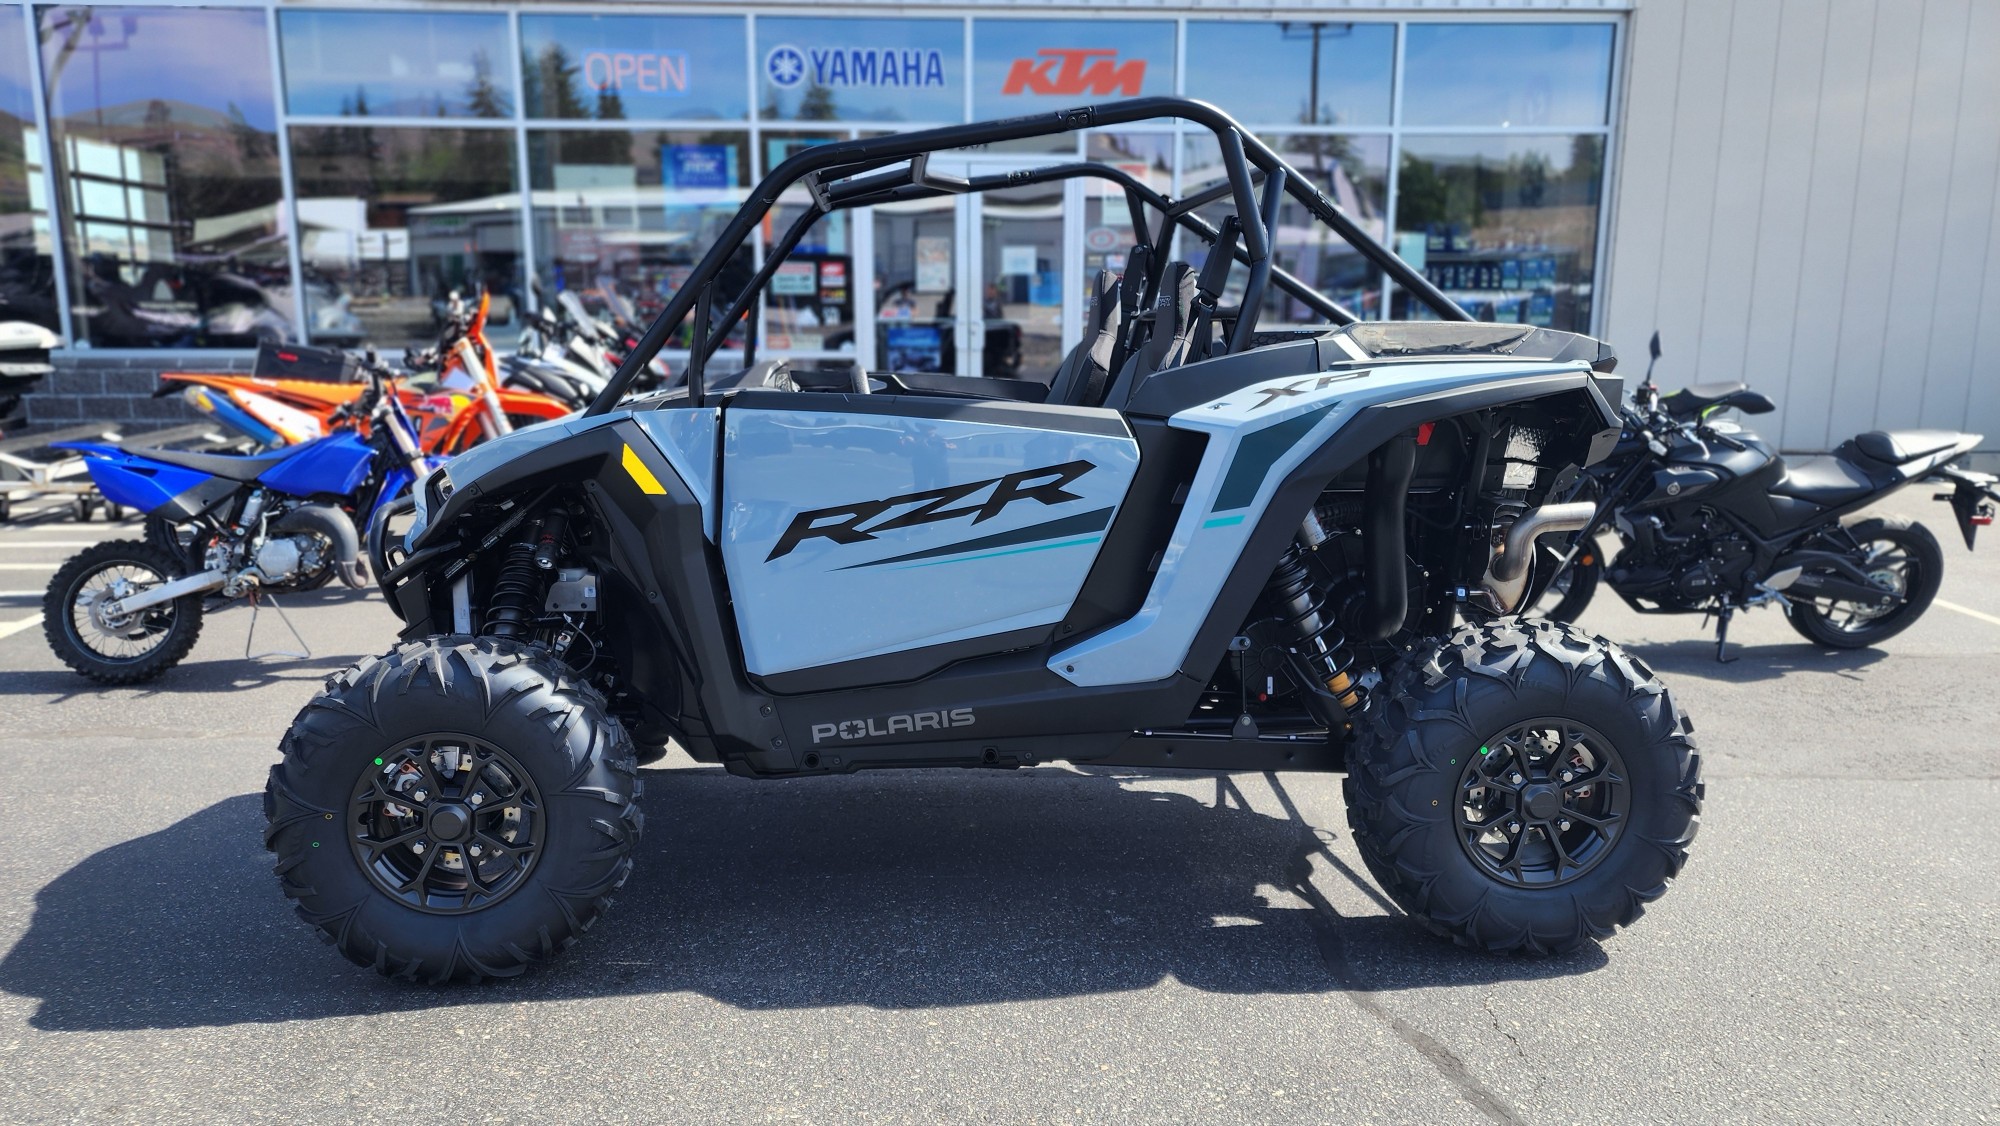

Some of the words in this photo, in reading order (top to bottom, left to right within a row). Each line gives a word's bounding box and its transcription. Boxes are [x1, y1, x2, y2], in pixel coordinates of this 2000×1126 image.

[585, 52, 686, 92] OPEN
[811, 50, 944, 87] YAMAHA
[1002, 49, 1147, 96] KTM
[1246, 370, 1372, 412] XP
[763, 459, 1097, 563] RZR
[811, 707, 976, 744] POLARIS
